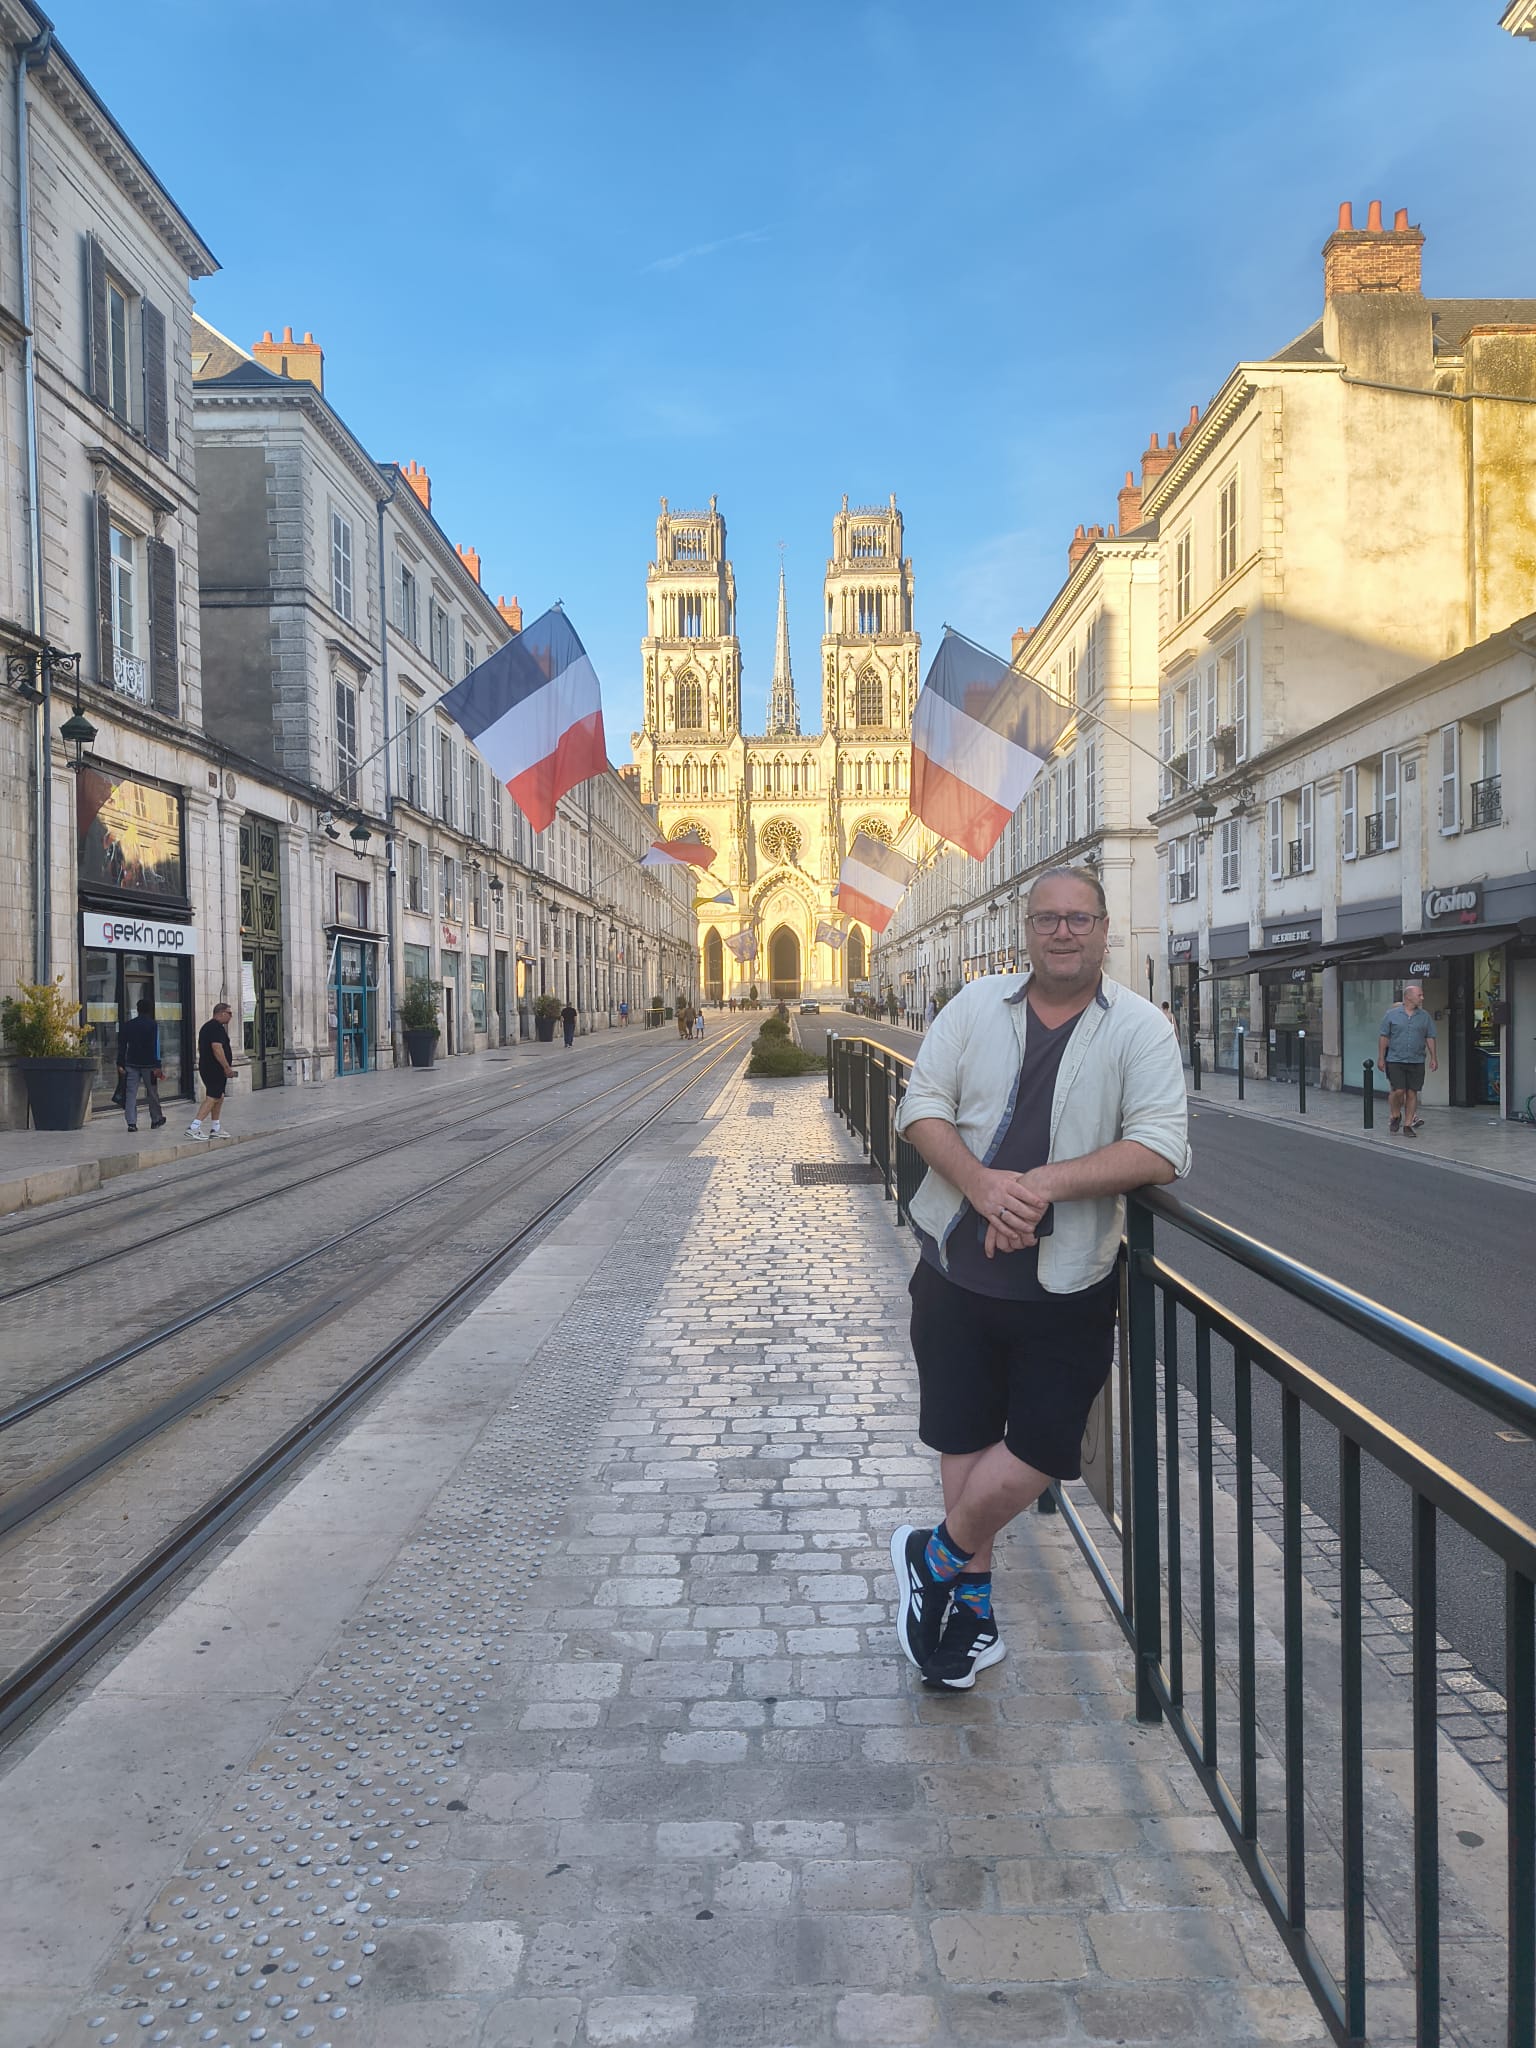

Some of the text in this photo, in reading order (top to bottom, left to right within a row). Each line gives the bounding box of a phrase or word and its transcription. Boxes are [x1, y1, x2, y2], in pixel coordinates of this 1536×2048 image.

[1425, 887, 1477, 920] Casino
[103, 920, 184, 950] geek'n pop
[1409, 961, 1431, 975] Casino
